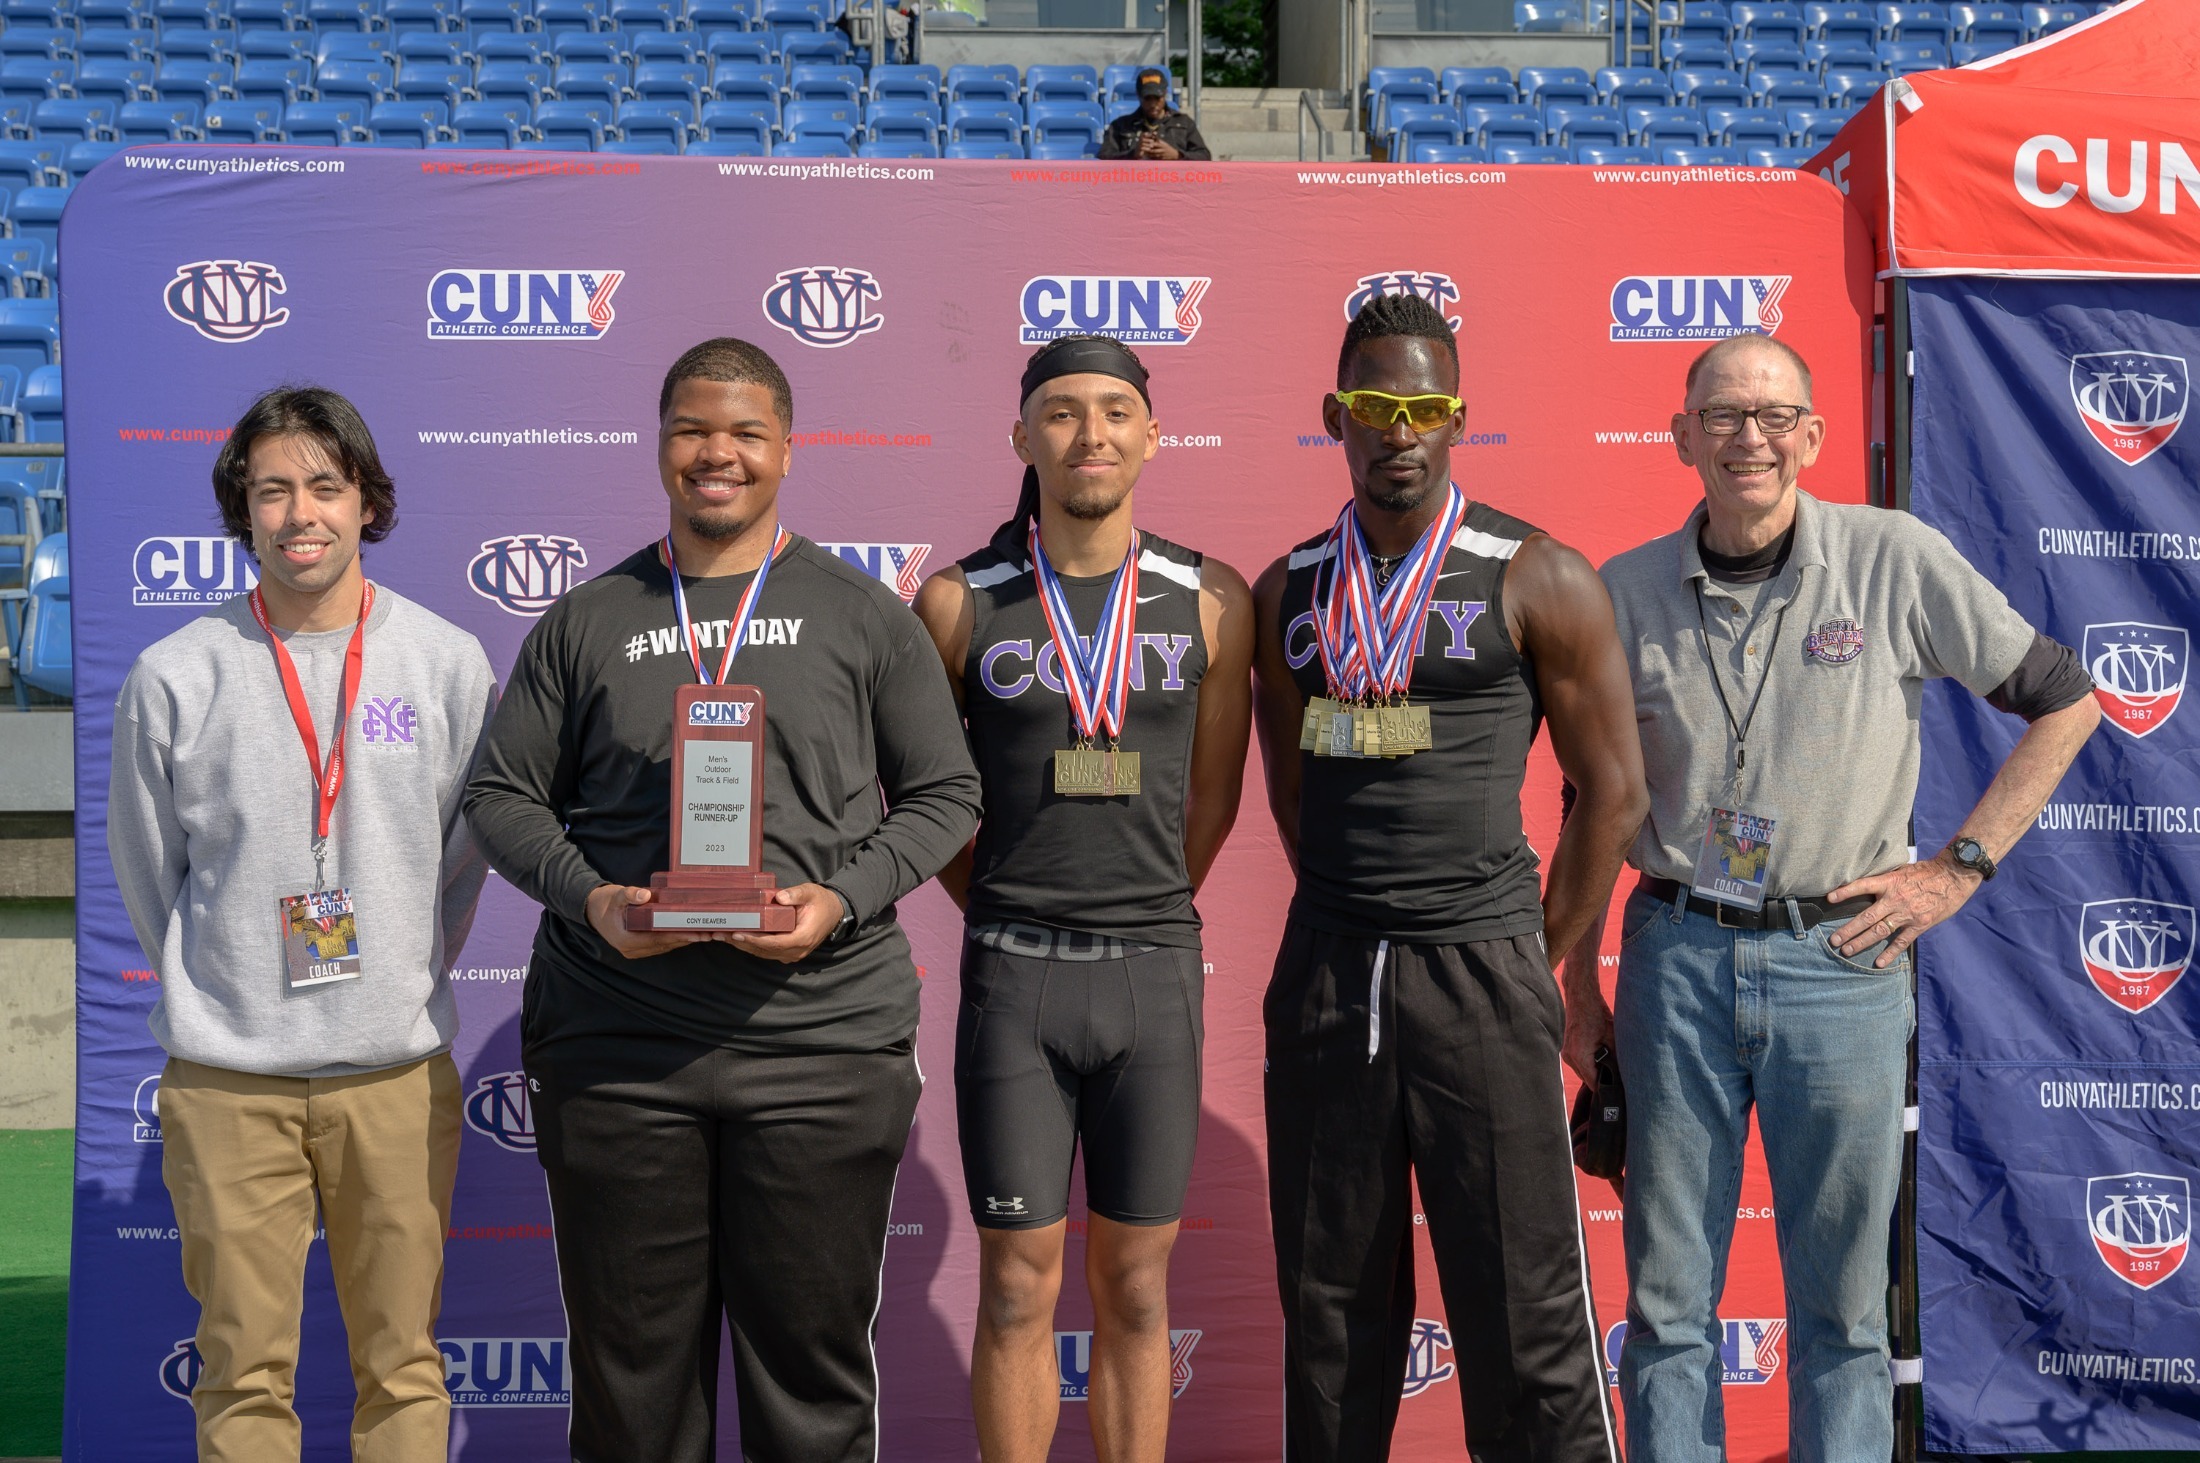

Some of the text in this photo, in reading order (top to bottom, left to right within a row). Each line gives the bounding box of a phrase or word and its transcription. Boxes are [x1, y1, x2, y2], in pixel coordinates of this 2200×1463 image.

[124, 154, 345, 176] www.cunyathletics.com
[421, 160, 640, 177] www.cunyathletics.com
[718, 161, 934, 181] www.cunyathletics.com
[1011, 167, 1222, 185] www.cunyathletics.com
[1297, 169, 1506, 187] www.cunyathletics.com
[1593, 168, 1797, 185] www.cunyathletics.com
[430, 272, 620, 328] CUNY
[1024, 278, 1208, 334] CUNY
[1613, 278, 1789, 329] CUNY
[435, 325, 588, 335] ATHLETIC CONFERENCE
[1617, 329, 1673, 338] ATHLETIC
[418, 428, 637, 447] www.cunyathletics.com
[792, 429, 932, 447] nyathletics.com
[2113, 437, 2142, 450] 1987
[2038, 527, 2200, 560] CUNYATHLETICS.C
[136, 540, 259, 590] CUN
[141, 592, 200, 601] ATHLETIC
[625, 618, 803, 662] #WNTDAY
[690, 703, 752, 722] CUNY
[2123, 709, 2152, 721] 1987
[708, 755, 728, 763] Men's
[696, 776, 714, 784] Track
[688, 803, 745, 812] CHAMPIONSHIP
[694, 814, 738, 822] RUNNER-UP
[1714, 878, 1743, 895] COACH
[317, 901, 351, 914] CUNY
[309, 962, 340, 978] COACH
[2119, 985, 2150, 997] 1987
[2130, 1260, 2160, 1272] 1987
[438, 1341, 563, 1391] CUN
[450, 1392, 569, 1402] LETIC CONFERENC
